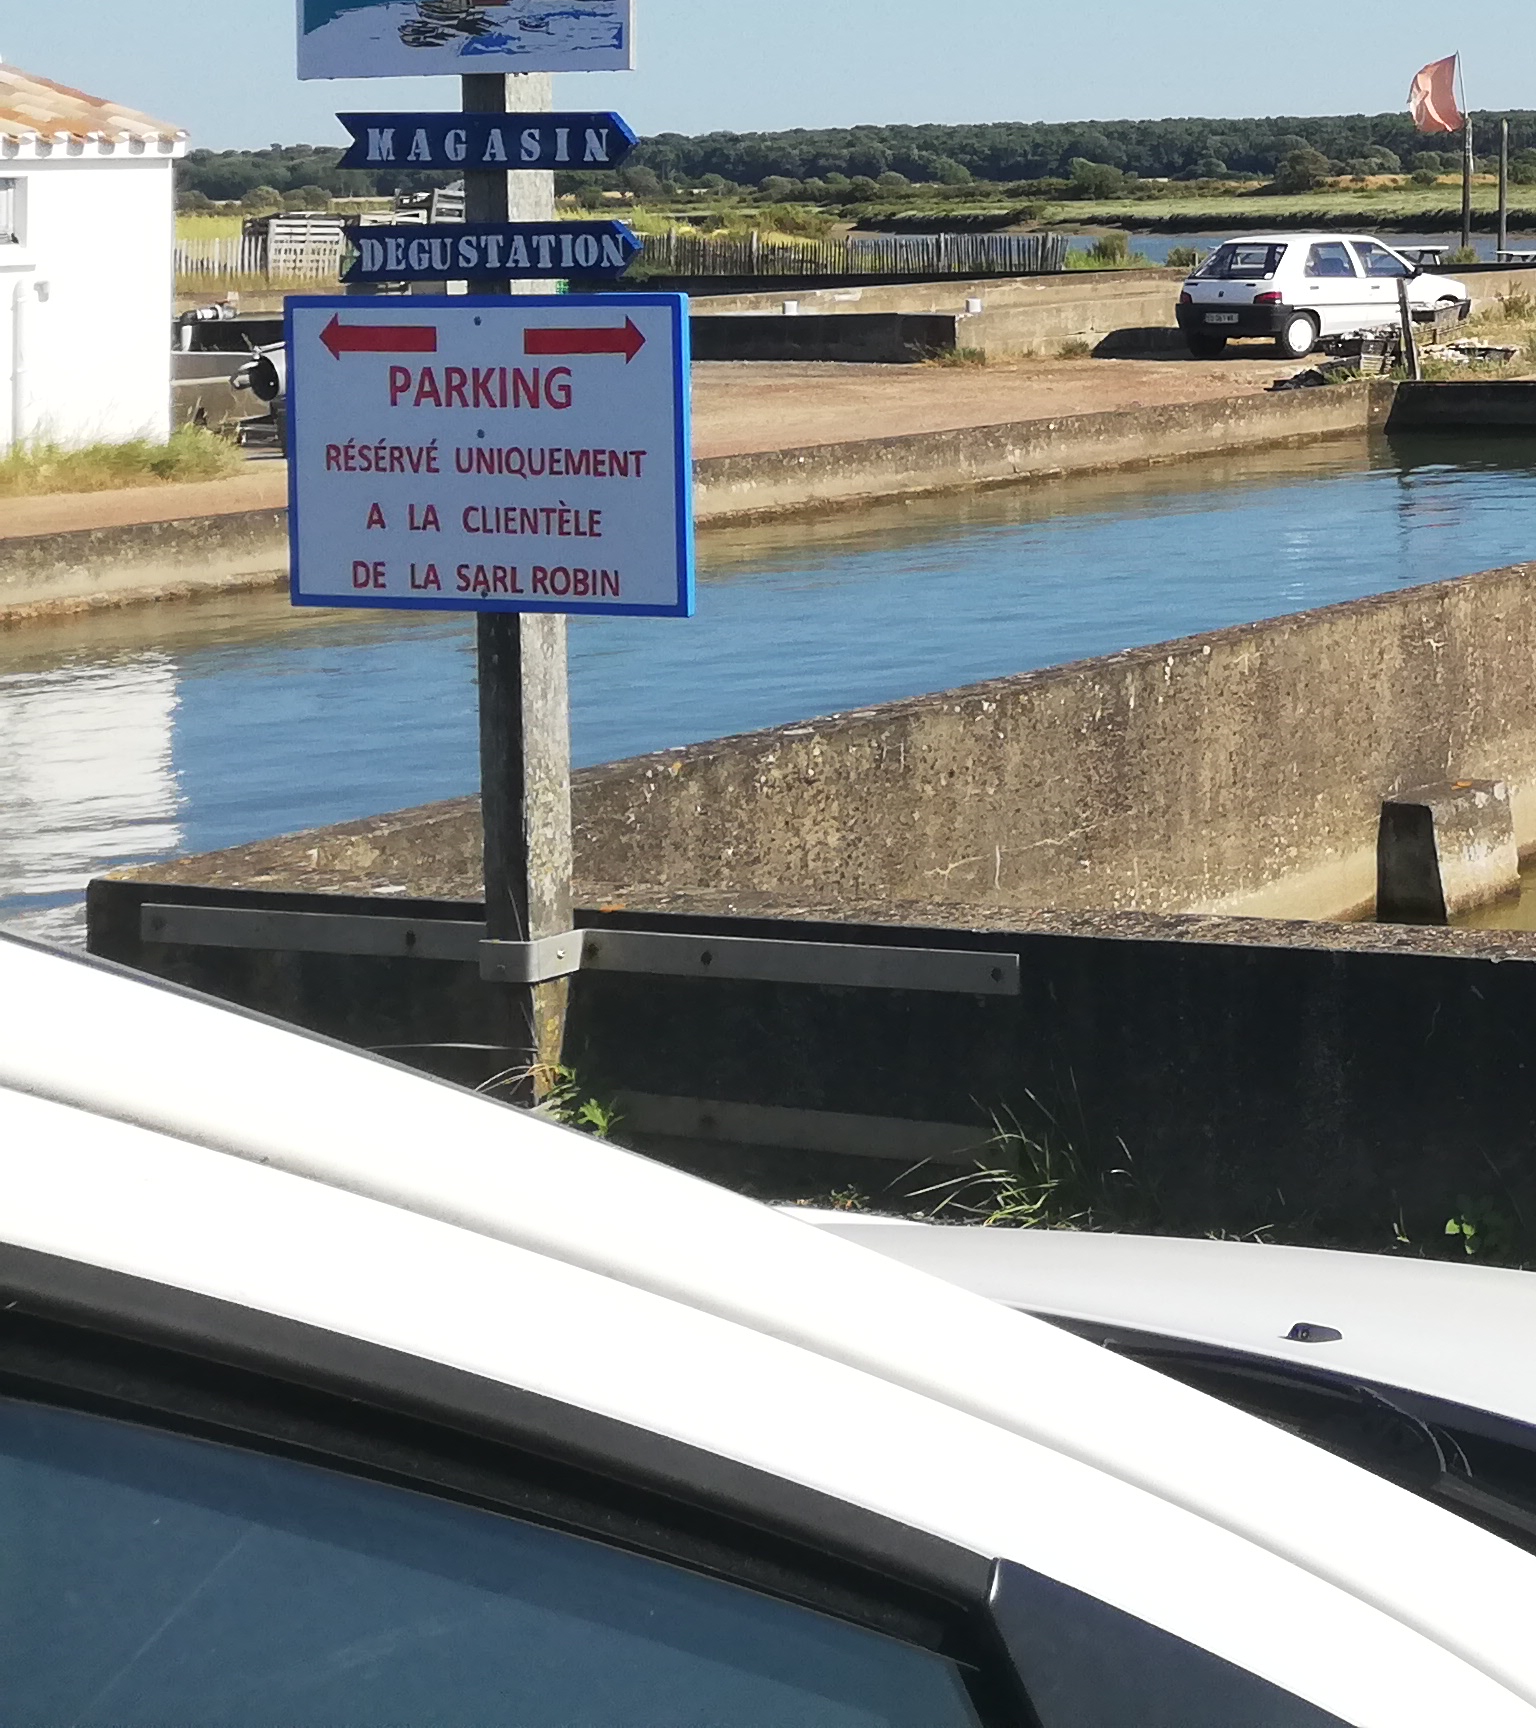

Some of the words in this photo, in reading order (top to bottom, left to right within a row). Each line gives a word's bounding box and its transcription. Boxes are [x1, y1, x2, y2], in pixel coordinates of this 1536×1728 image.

[366, 128, 609, 162] MAGASIN
[359, 233, 626, 272] DEGUSTATION
[389, 365, 573, 409] PARKING
[325, 437, 440, 473] RÉSÉRVÉ
[455, 446, 647, 479] UNIQUEMENT
[366, 502, 386, 530] A
[408, 503, 440, 532] LA
[462, 500, 603, 537] CLIENTÈLE
[352, 561, 386, 589] DE
[410, 562, 441, 591] LA
[456, 563, 525, 595] SARL
[532, 566, 620, 597] ROBIN
